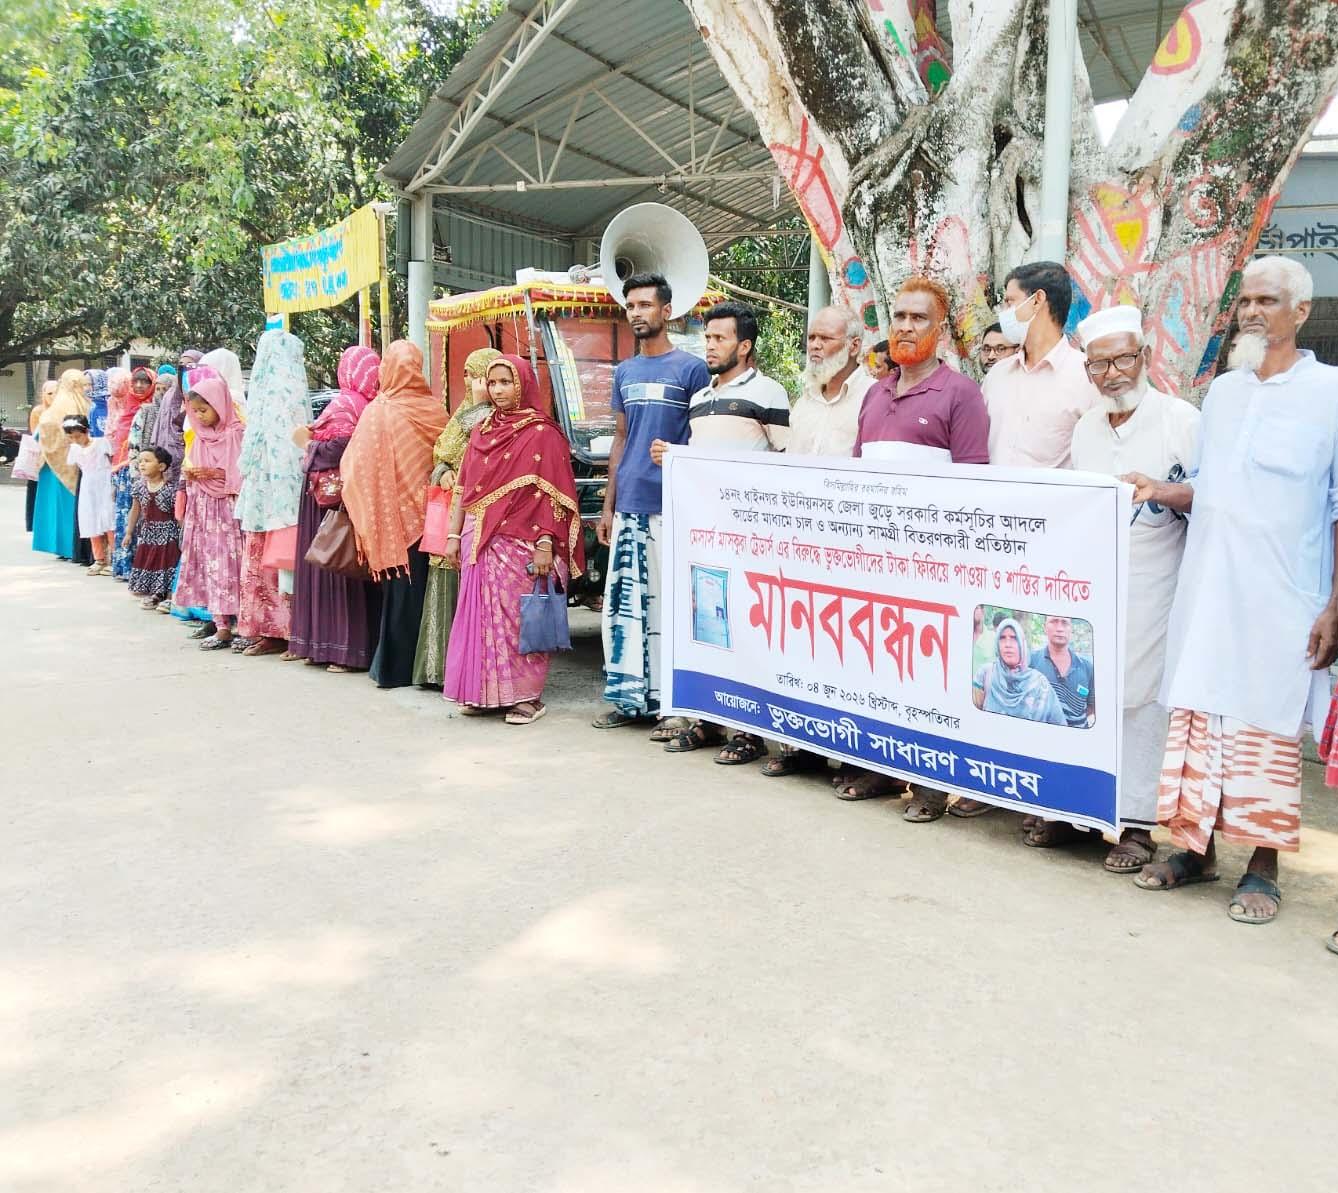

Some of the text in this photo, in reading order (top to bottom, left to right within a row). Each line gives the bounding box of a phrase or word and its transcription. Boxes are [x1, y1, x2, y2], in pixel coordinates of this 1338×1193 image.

[743, 567, 960, 691] মানববন্ধন
[714, 689, 1041, 797] আয়োজনে: ভুক্তভোগী সাধারণ মানুষ
